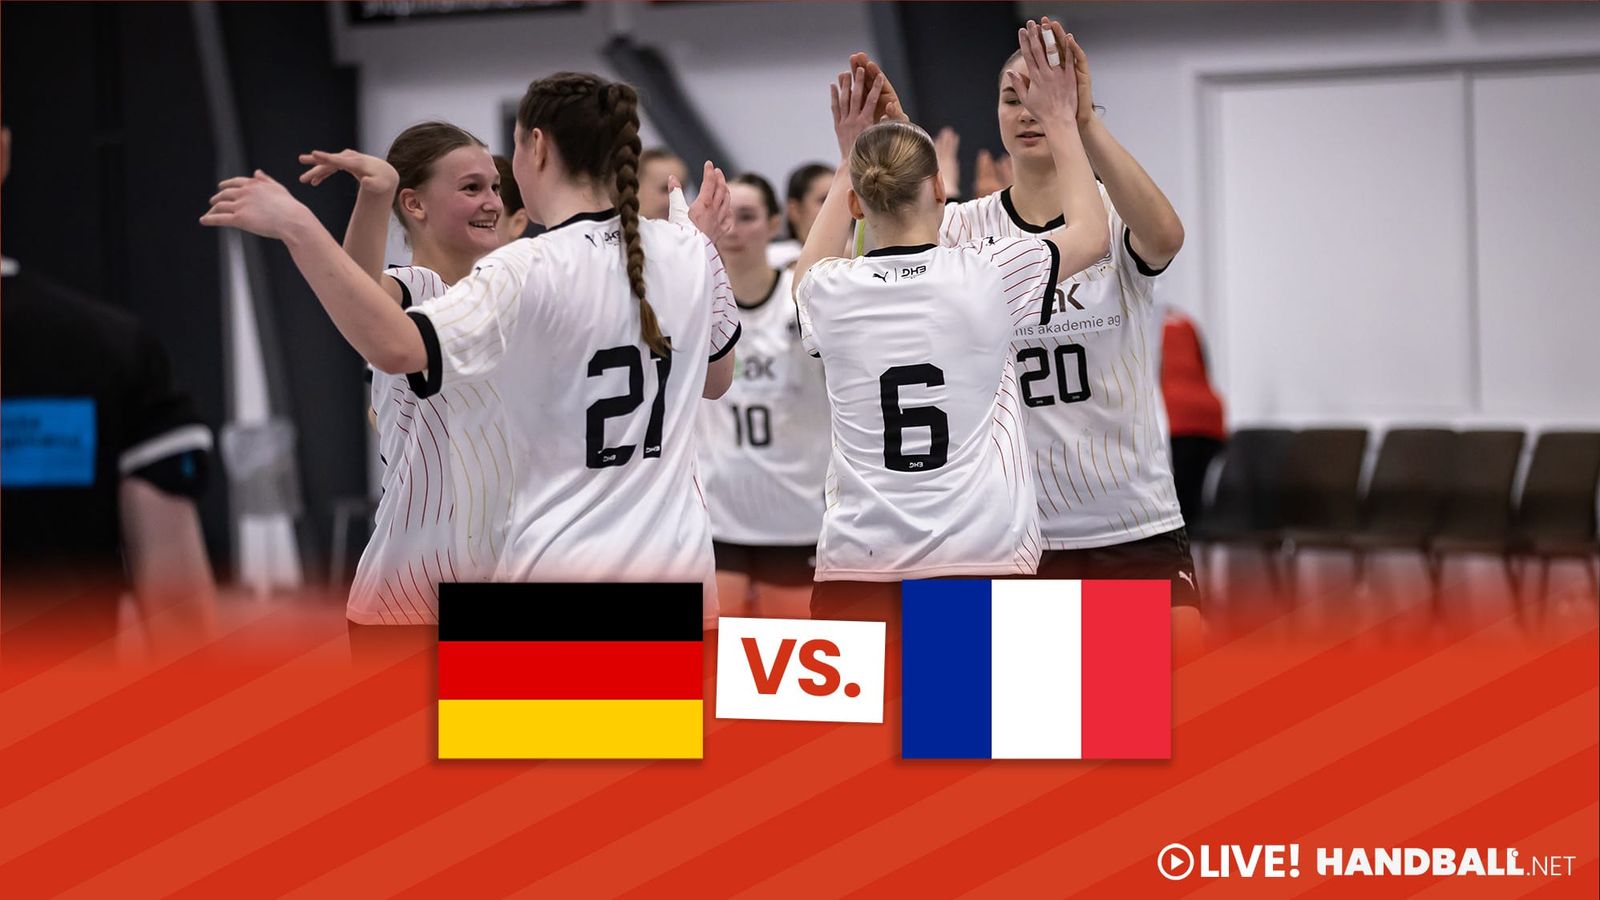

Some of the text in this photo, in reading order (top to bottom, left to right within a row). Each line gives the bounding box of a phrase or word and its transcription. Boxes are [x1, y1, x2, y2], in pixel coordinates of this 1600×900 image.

[1038, 315, 1104, 336] akademie
[1107, 314, 1121, 328] ag
[585, 335, 673, 469] 21
[1016, 343, 1092, 408] 20
[730, 404, 772, 448] 10
[879, 362, 950, 472] 6
